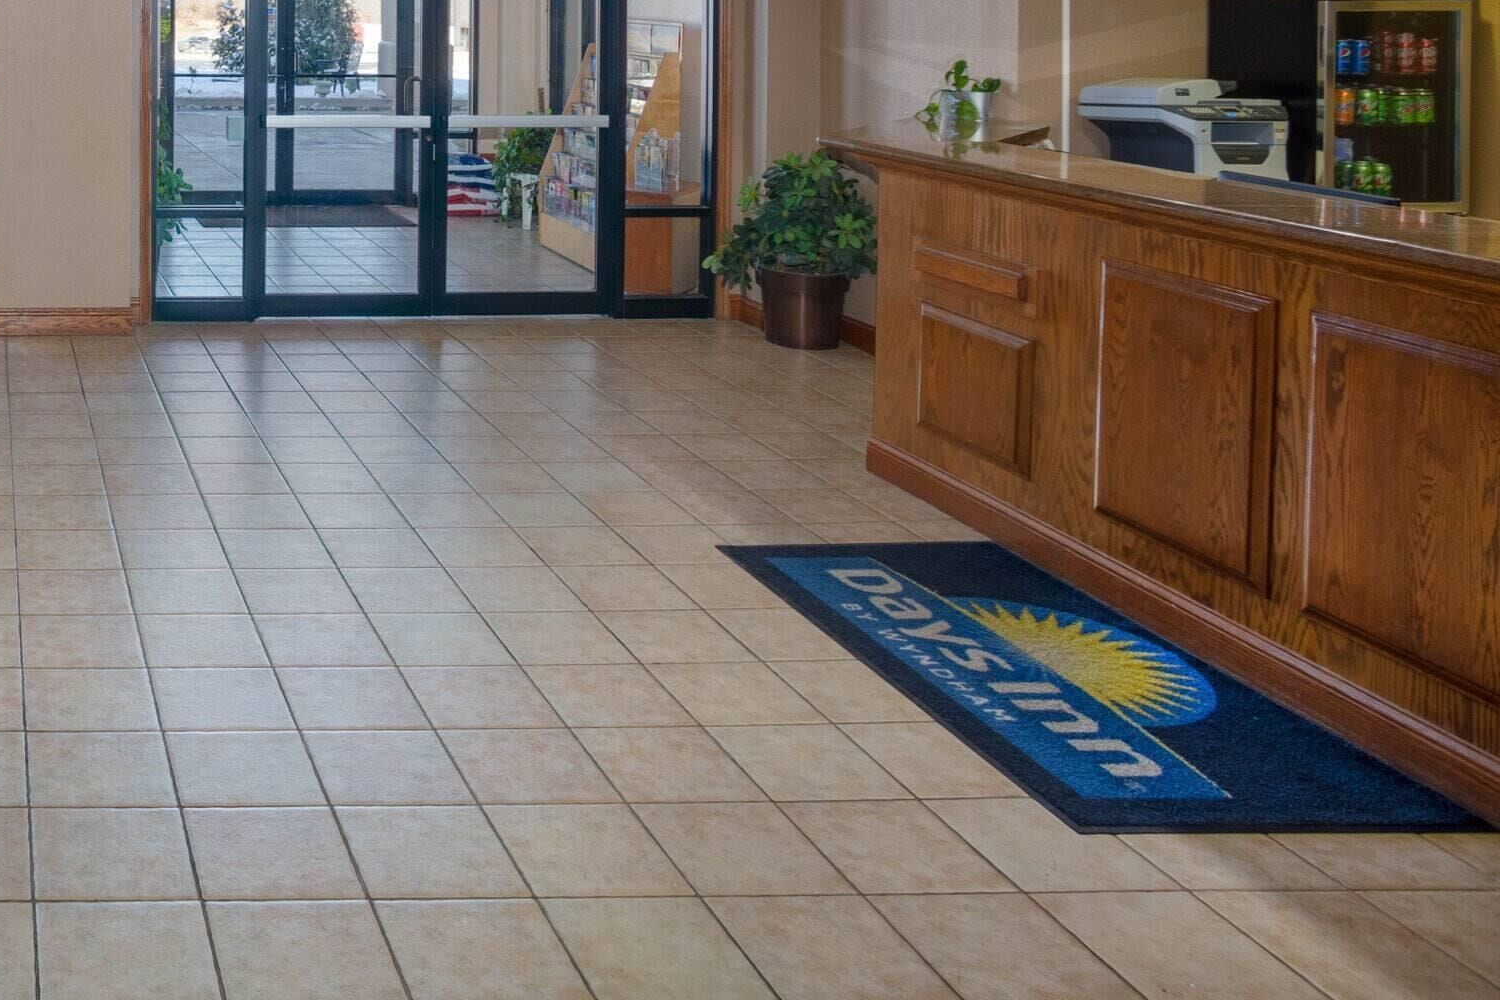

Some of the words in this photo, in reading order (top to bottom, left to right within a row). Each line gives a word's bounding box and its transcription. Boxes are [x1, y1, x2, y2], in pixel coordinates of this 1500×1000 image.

[827, 568, 1014, 673] Days
[987, 682, 1163, 778] Inn
[841, 602, 879, 622] BY
[877, 627, 1018, 722] WYNDHAM
